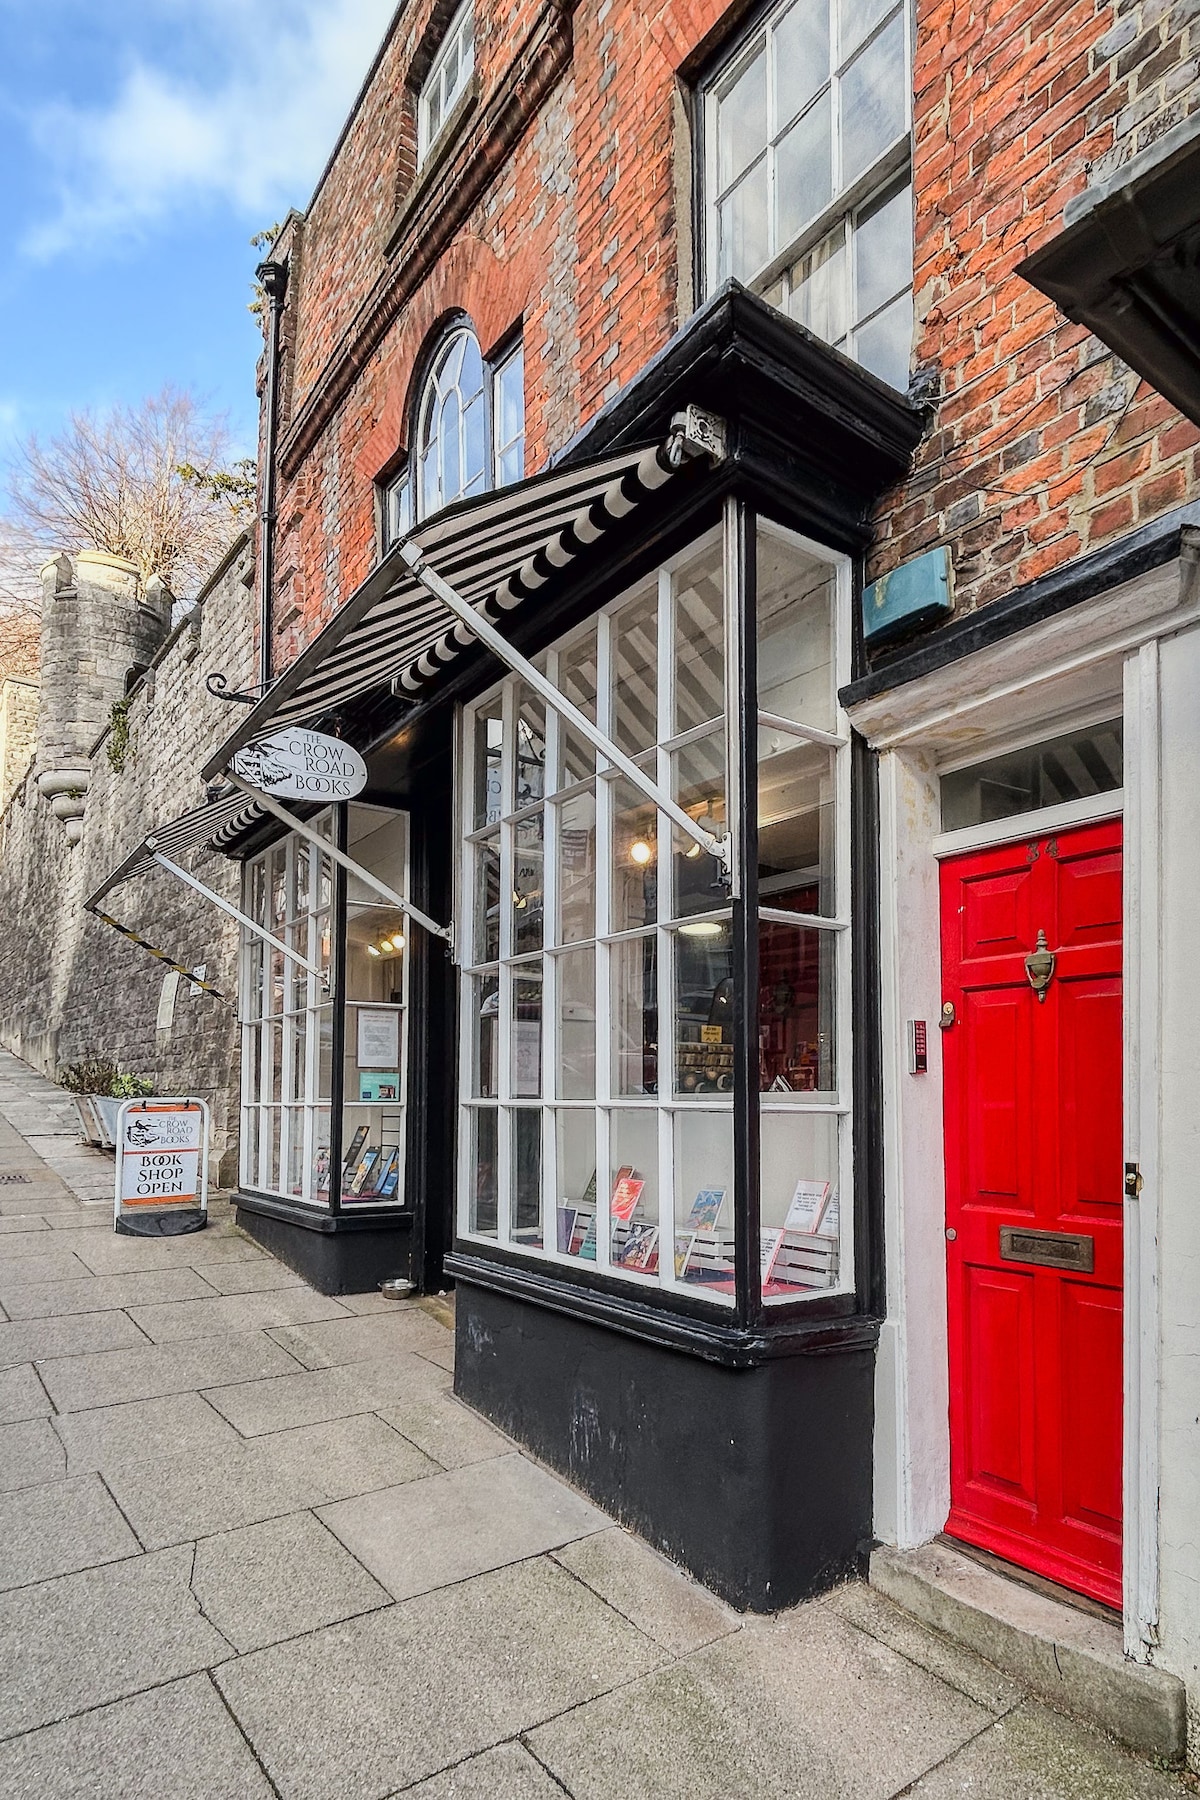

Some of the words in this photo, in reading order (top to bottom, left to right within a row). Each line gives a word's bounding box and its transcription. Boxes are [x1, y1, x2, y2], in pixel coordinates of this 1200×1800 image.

[304, 734, 322, 744] THE
[289, 740, 344, 761] CROW
[305, 757, 355, 777] ROAD
[295, 774, 351, 796] BOOKS
[1026, 837, 1060, 863] 34
[159, 1120, 188, 1128] CROW
[160, 1135, 190, 1144] BOOKS
[141, 1154, 182, 1167] BOOK
[138, 1168, 183, 1182] SHOP
[137, 1182, 182, 1194] OPEN
